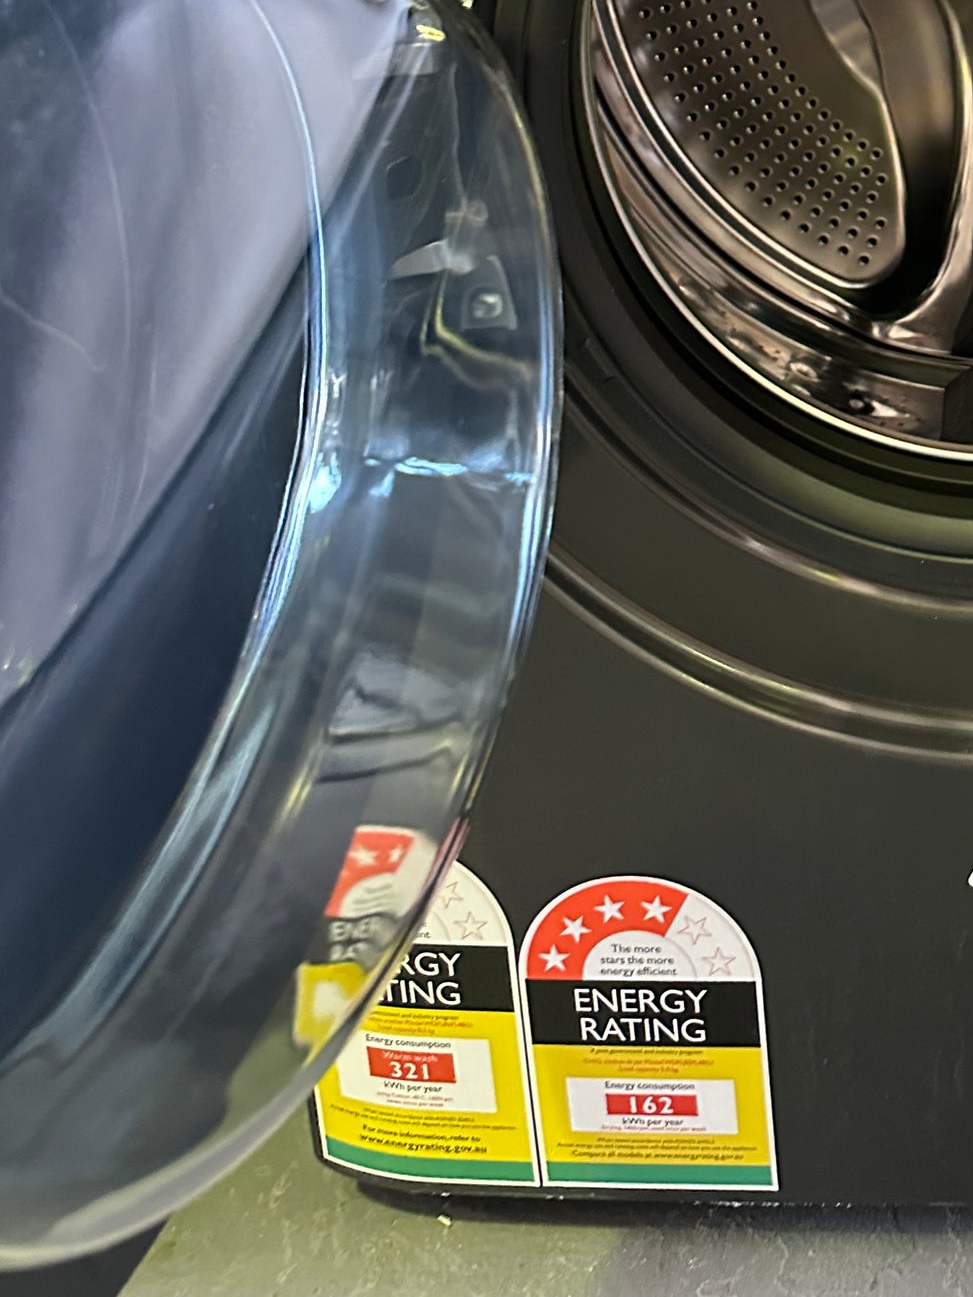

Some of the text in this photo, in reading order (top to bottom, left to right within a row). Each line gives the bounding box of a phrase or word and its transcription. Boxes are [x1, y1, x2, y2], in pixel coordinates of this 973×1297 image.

[611, 943, 632, 953] The
[600, 957, 625, 965] stars
[627, 956, 644, 965] the
[600, 967, 678, 977] energy efficient
[573, 988, 707, 1014] ENERGY
[580, 1017, 706, 1042] RATING
[365, 1033, 452, 1049] Energy consumption
[390, 1062, 430, 1080] 321
[425, 1085, 442, 1093] year
[604, 1081, 695, 1091] Energy consumption
[629, 1096, 674, 1114] 162
[664, 1119, 684, 1127] year
